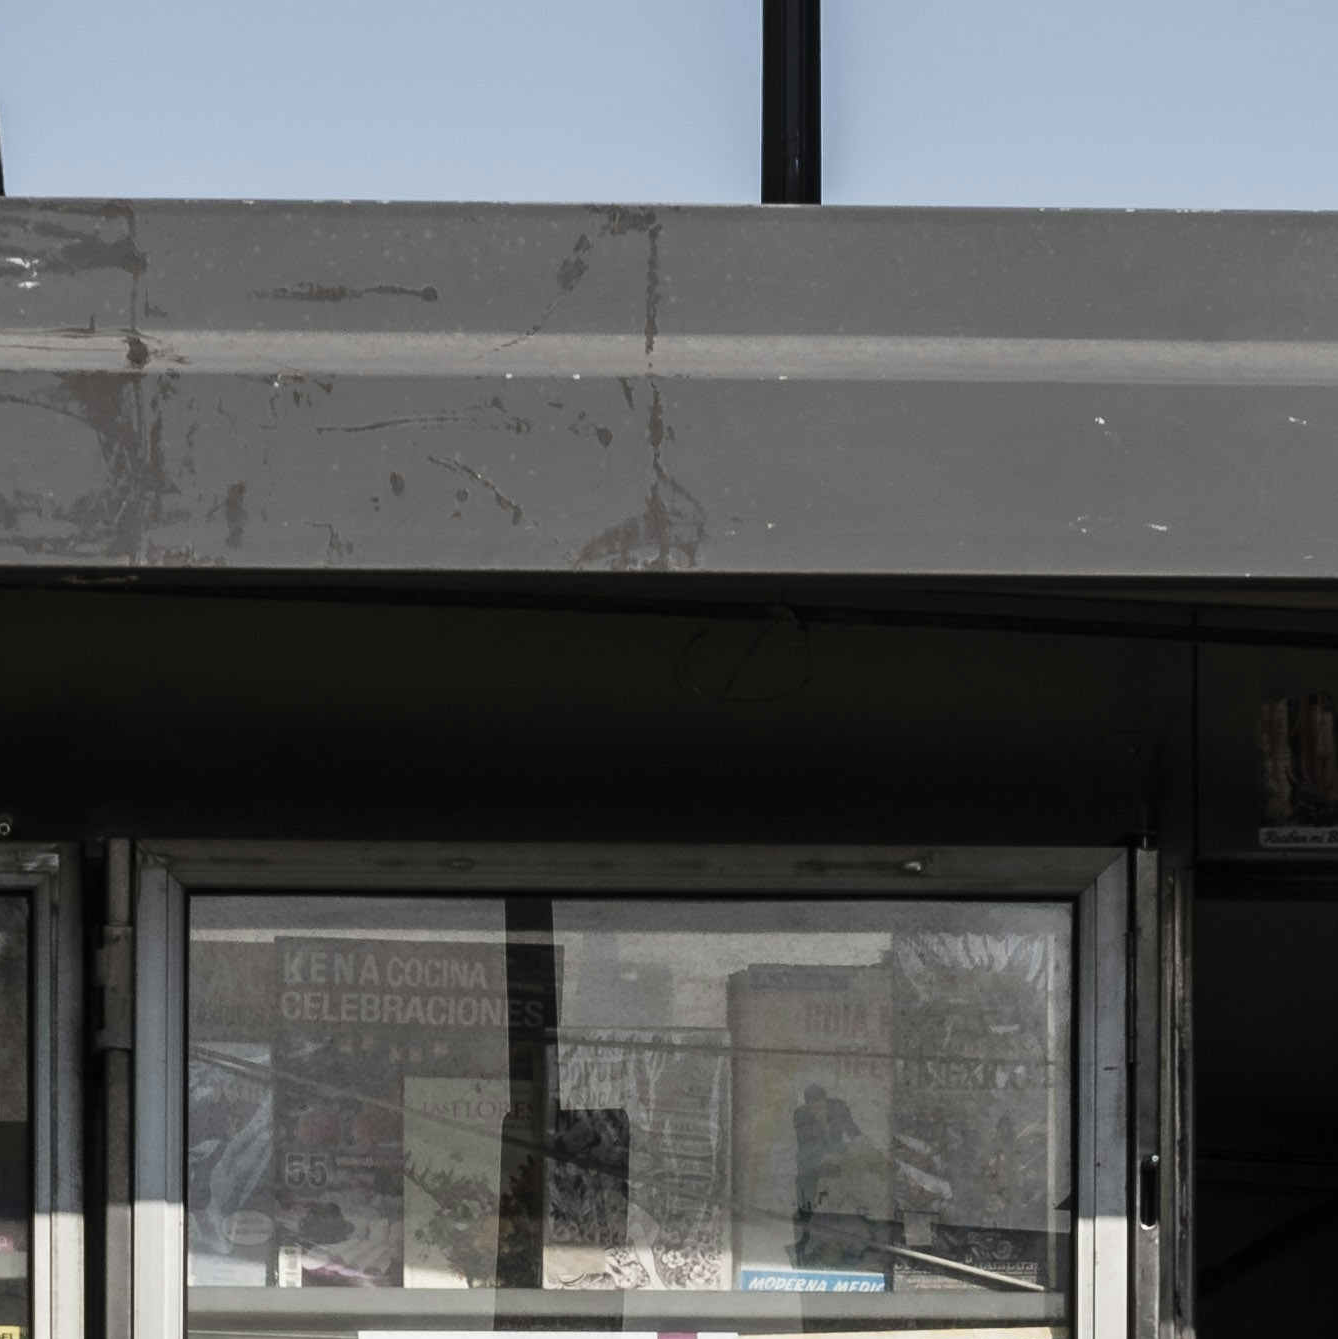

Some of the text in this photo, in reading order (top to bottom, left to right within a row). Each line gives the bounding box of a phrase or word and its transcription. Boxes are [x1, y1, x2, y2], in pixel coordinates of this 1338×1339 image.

[283, 951, 488, 989] KENA COCINA
[281, 991, 544, 1027] CELEBRACIONES
[285, 1152, 328, 1188] 55
[749, 1276, 826, 1292] MODERNA
